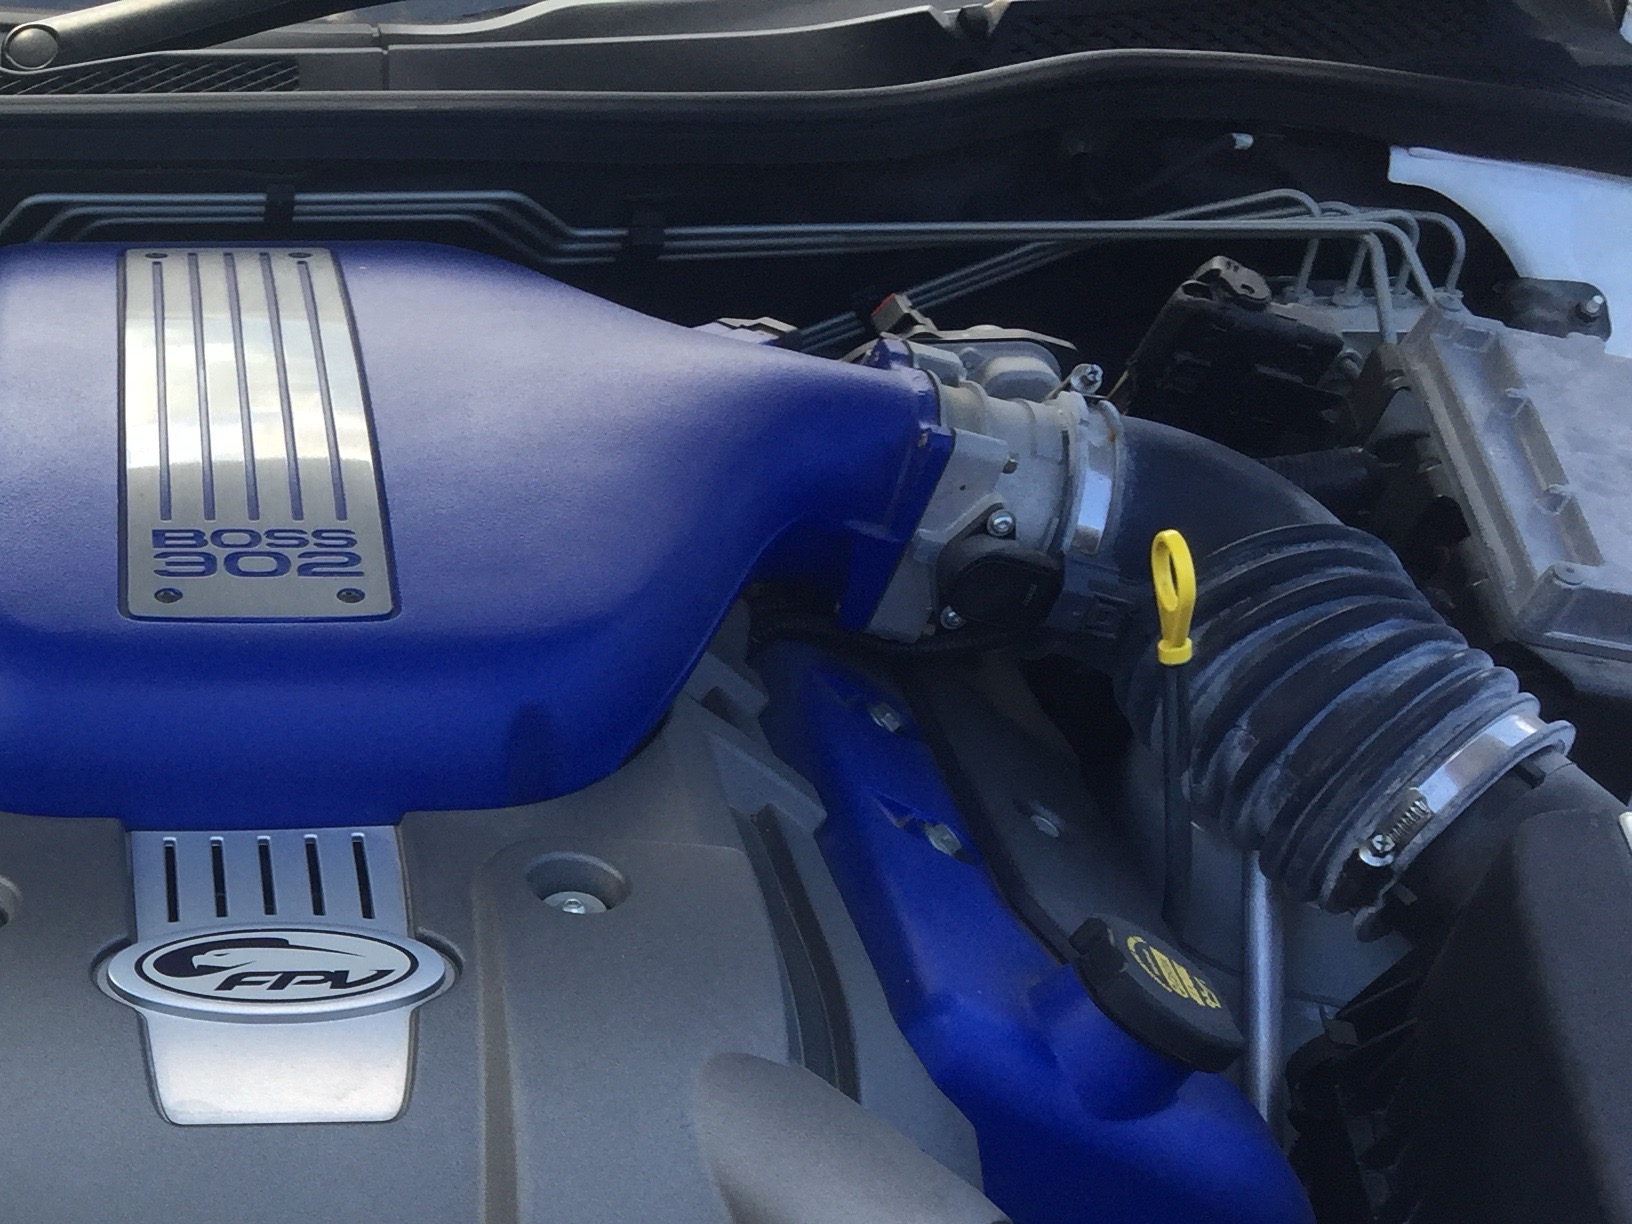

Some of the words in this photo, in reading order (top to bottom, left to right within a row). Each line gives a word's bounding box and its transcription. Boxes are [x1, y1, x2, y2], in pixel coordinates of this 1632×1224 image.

[151, 528, 358, 549] BOSS
[152, 551, 365, 578] 302
[214, 969, 396, 991] FPV
